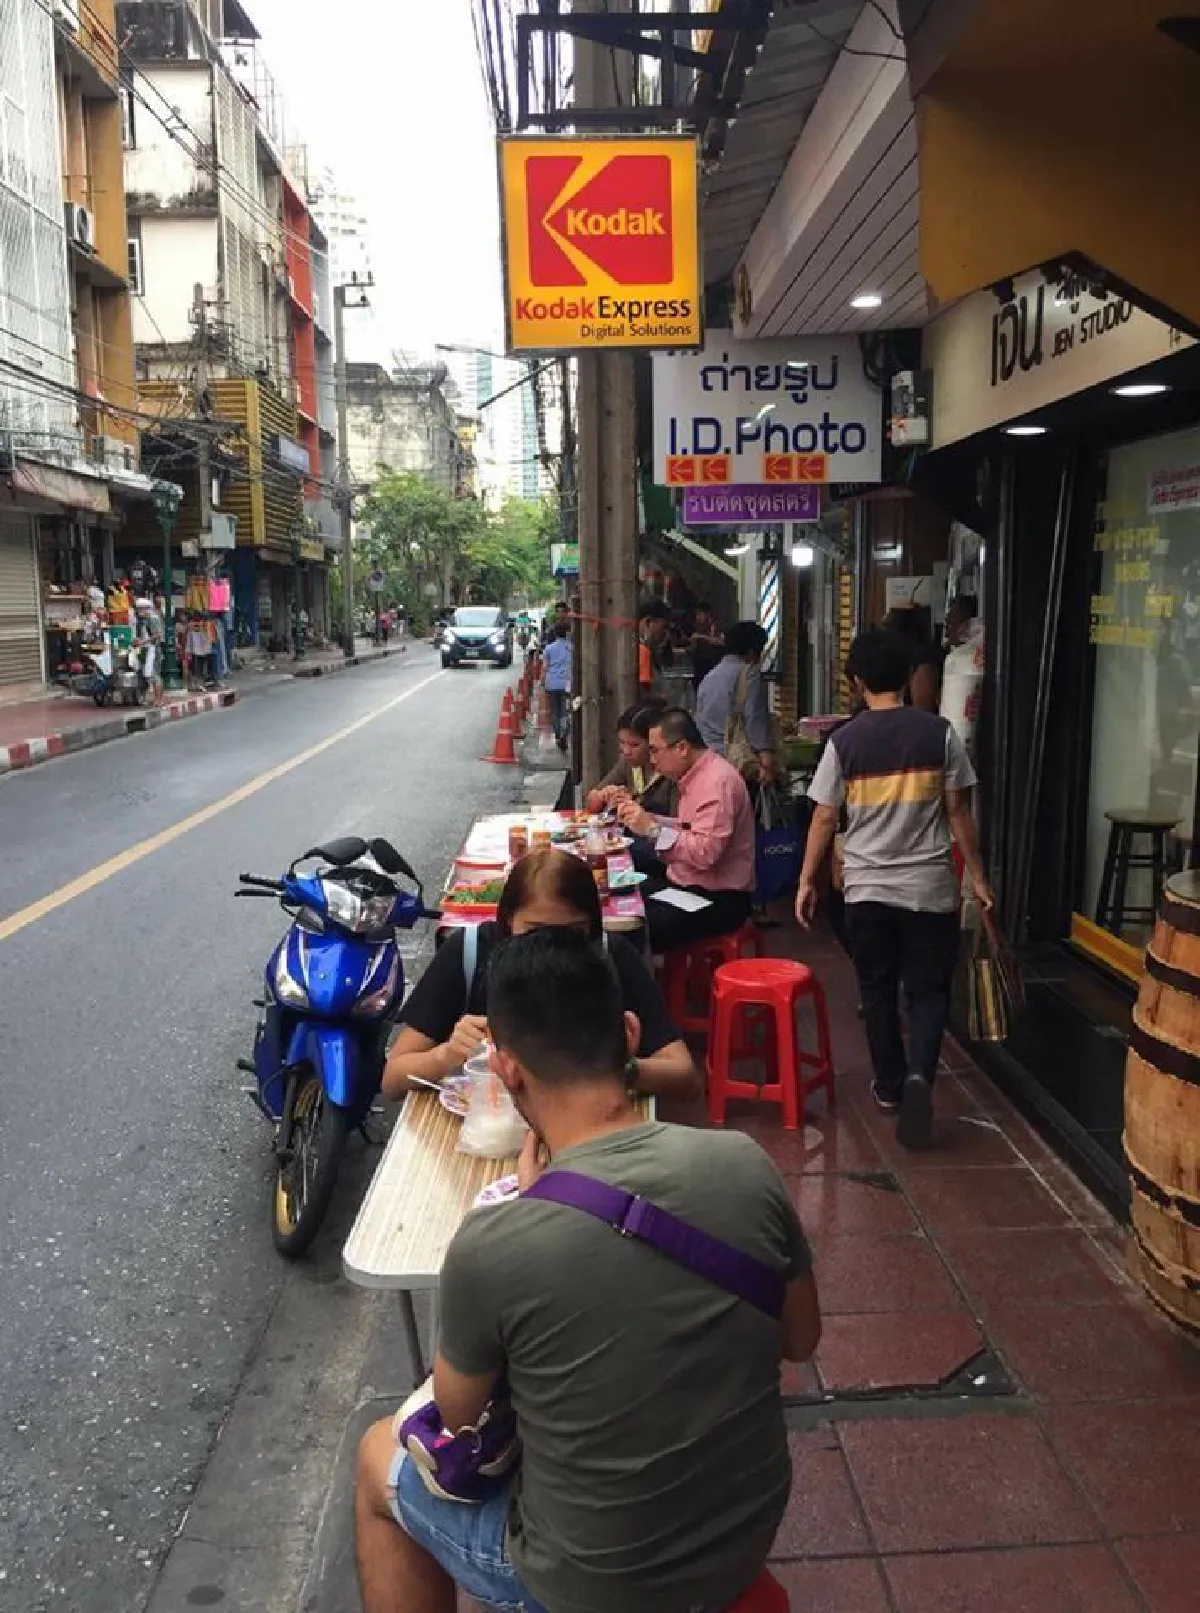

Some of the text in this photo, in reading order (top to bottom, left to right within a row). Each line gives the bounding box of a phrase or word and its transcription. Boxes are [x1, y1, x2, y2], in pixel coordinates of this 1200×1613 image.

[566, 207, 666, 235] Kodak
[581, 324, 692, 340] Digital Solutions
[1080, 299, 1132, 344] STUDIO
[700, 352, 838, 404] ถ่ายรูป
